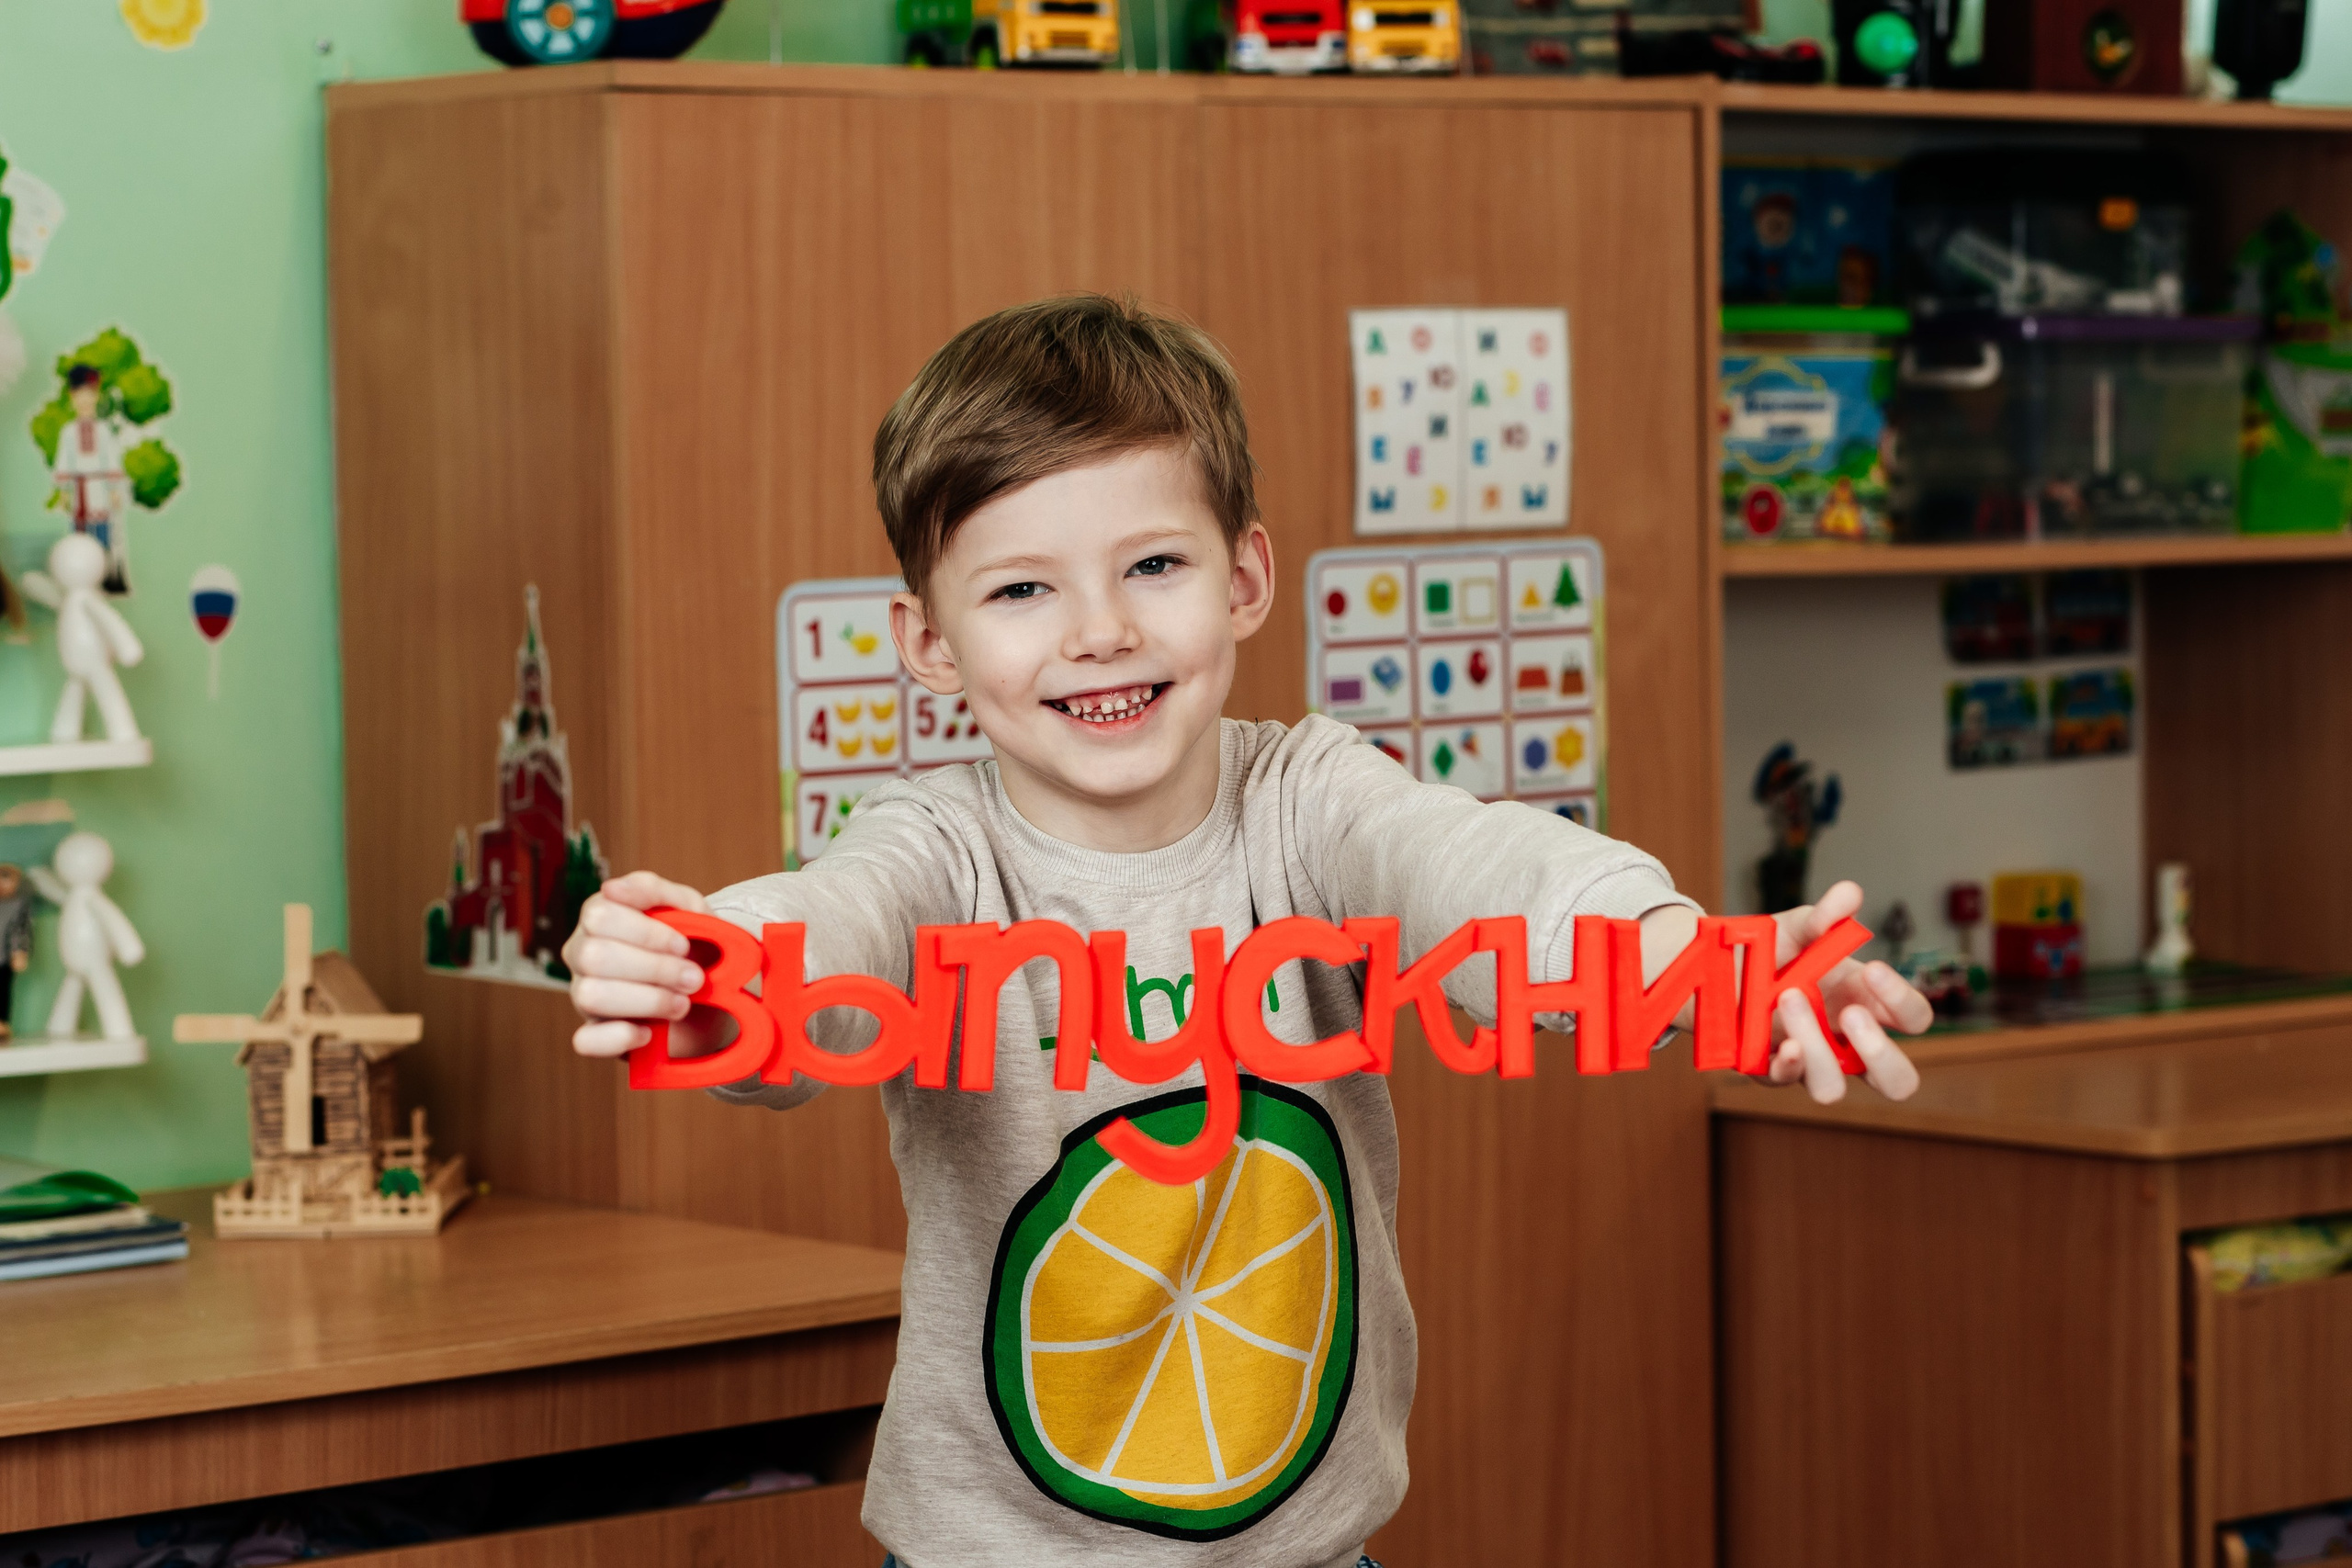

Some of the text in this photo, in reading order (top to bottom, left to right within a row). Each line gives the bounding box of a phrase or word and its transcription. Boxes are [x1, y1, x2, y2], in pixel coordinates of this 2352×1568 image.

[805, 617, 823, 659] 1
[808, 706, 829, 749] 4
[916, 696, 936, 739] 5
[808, 793, 828, 834] 7
